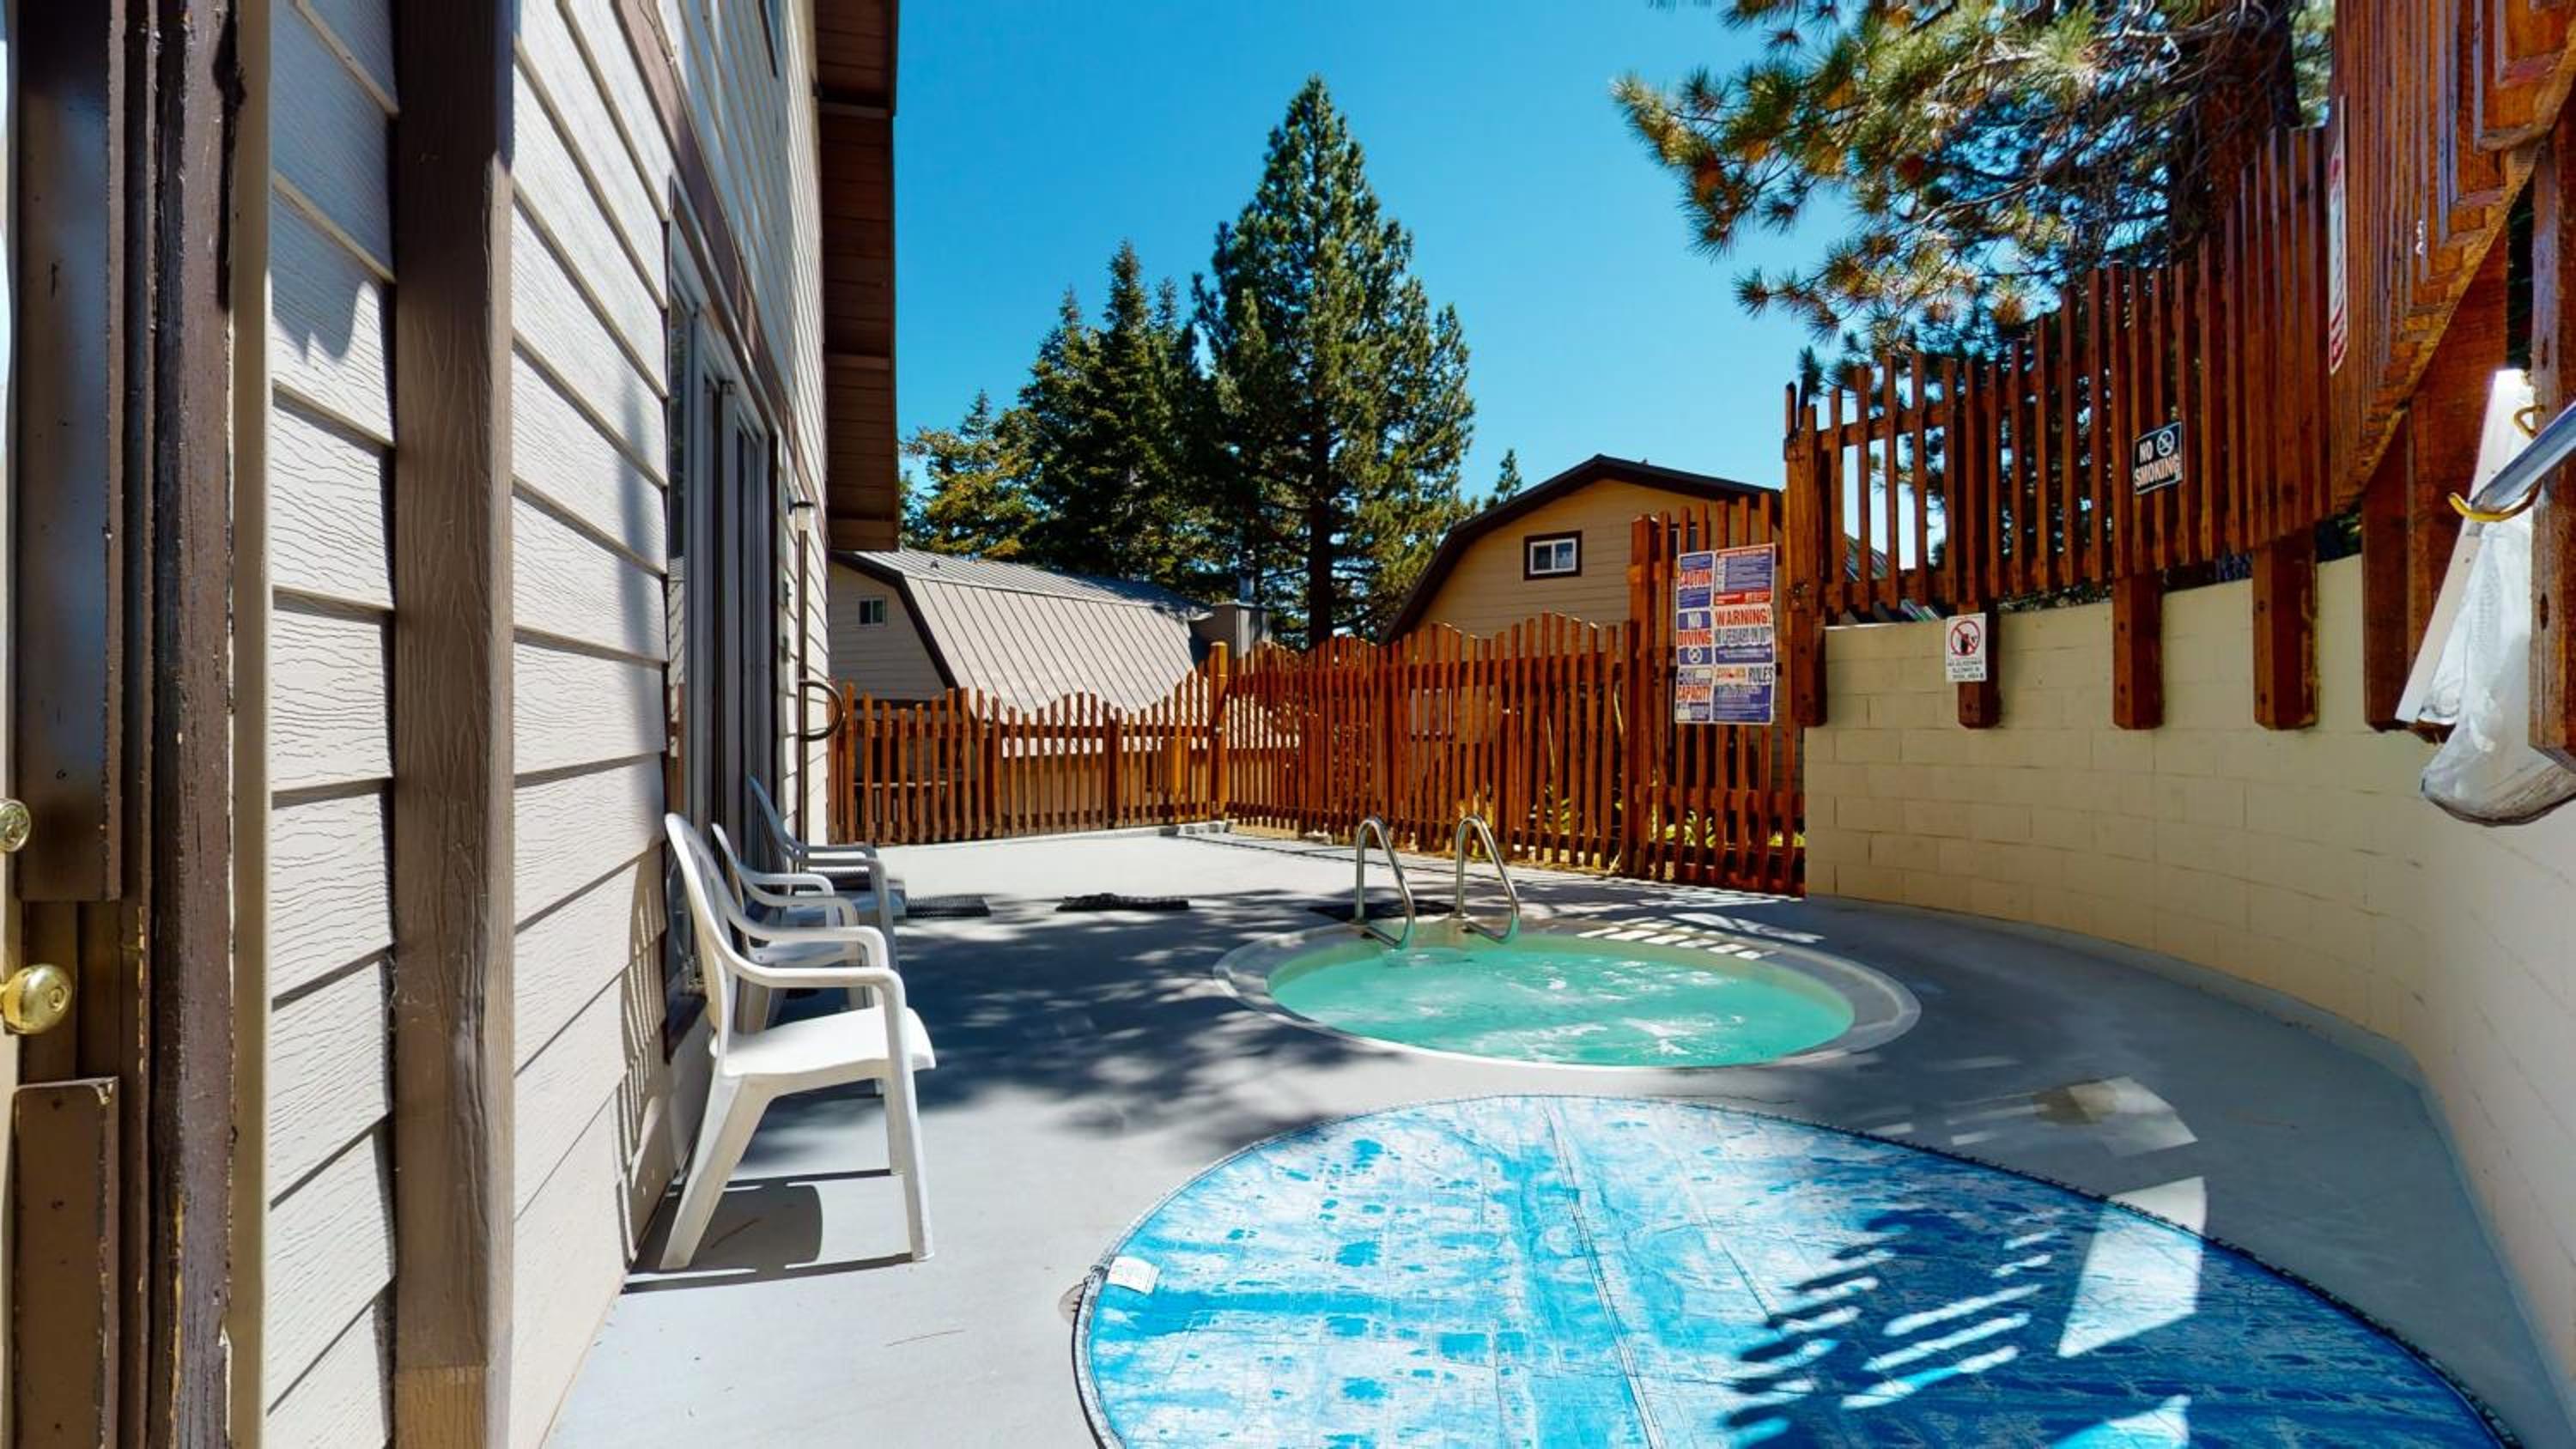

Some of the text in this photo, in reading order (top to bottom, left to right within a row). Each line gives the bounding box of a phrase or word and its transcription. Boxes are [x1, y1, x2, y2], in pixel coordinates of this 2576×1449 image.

[2139, 440, 2154, 463] NO
[2133, 454, 2181, 488] SMOKING
[1679, 569, 1711, 588] CAUTION
[1688, 613, 1703, 629] NO
[1716, 609, 1772, 627] WARNING!
[1678, 631, 1711, 647] DIVING
[1748, 667, 1772, 683] RULES
[1676, 686, 1710, 701] CAPACITY
